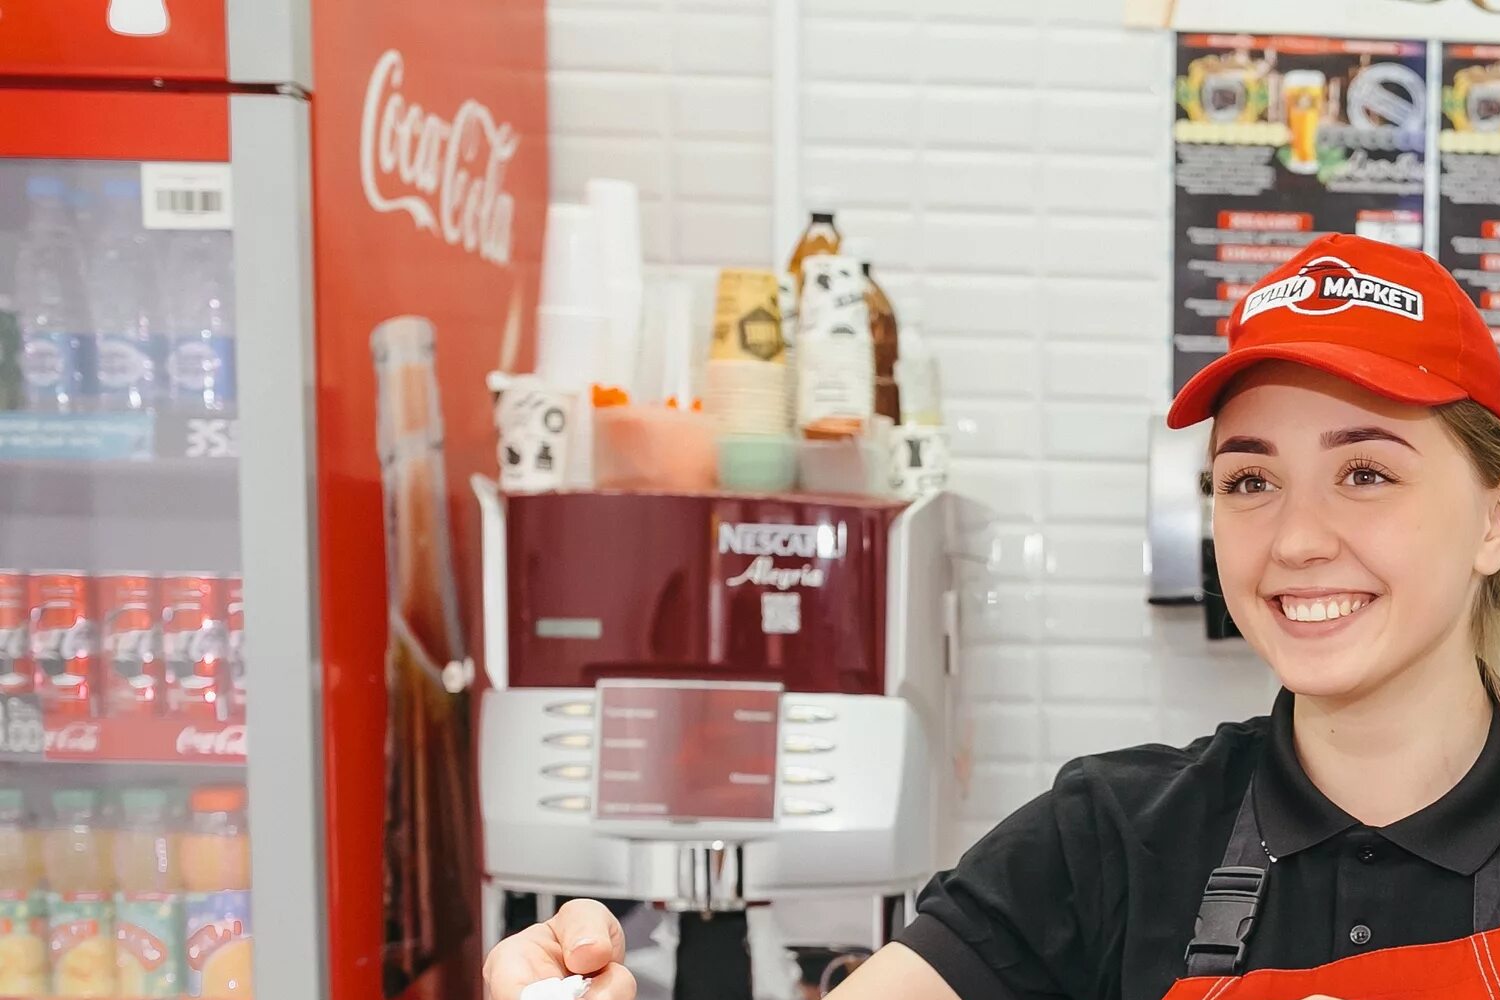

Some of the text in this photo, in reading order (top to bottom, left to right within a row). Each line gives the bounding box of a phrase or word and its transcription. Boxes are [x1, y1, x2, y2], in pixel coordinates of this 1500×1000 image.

[1249, 279, 1308, 312] СУШИ
[1324, 277, 1417, 311] МАРКЕТ
[719, 522, 838, 558] NESCAF
